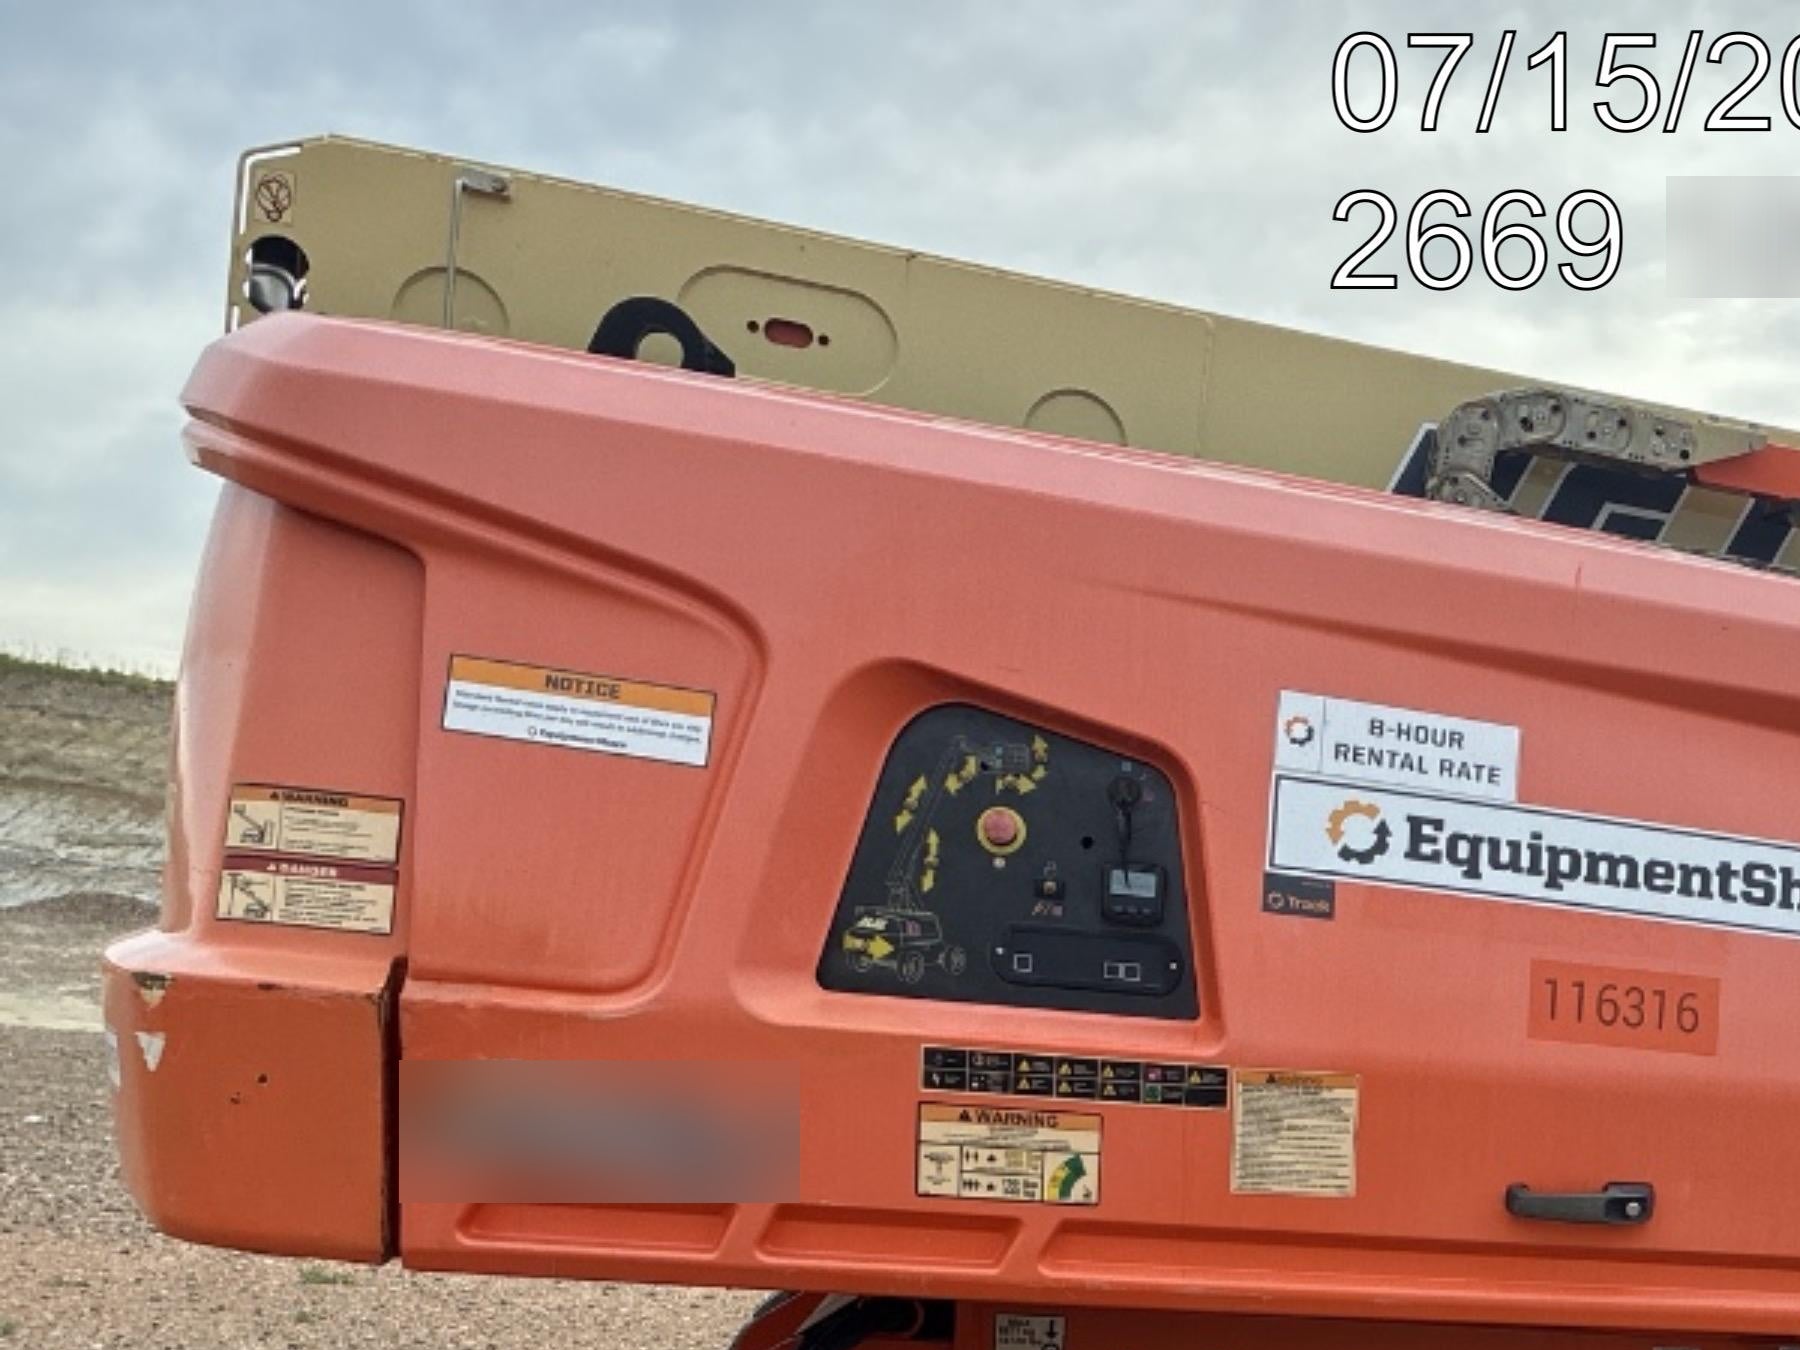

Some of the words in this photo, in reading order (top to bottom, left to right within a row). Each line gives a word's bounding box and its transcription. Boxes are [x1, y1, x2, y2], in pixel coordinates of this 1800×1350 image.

[545, 674, 623, 700] NOTICE
[1334, 742, 1430, 775] RENTAL
[1438, 757, 1502, 787] RATE
[1544, 978, 1699, 1034] 116316
[975, 1108, 1060, 1129] WARNING
